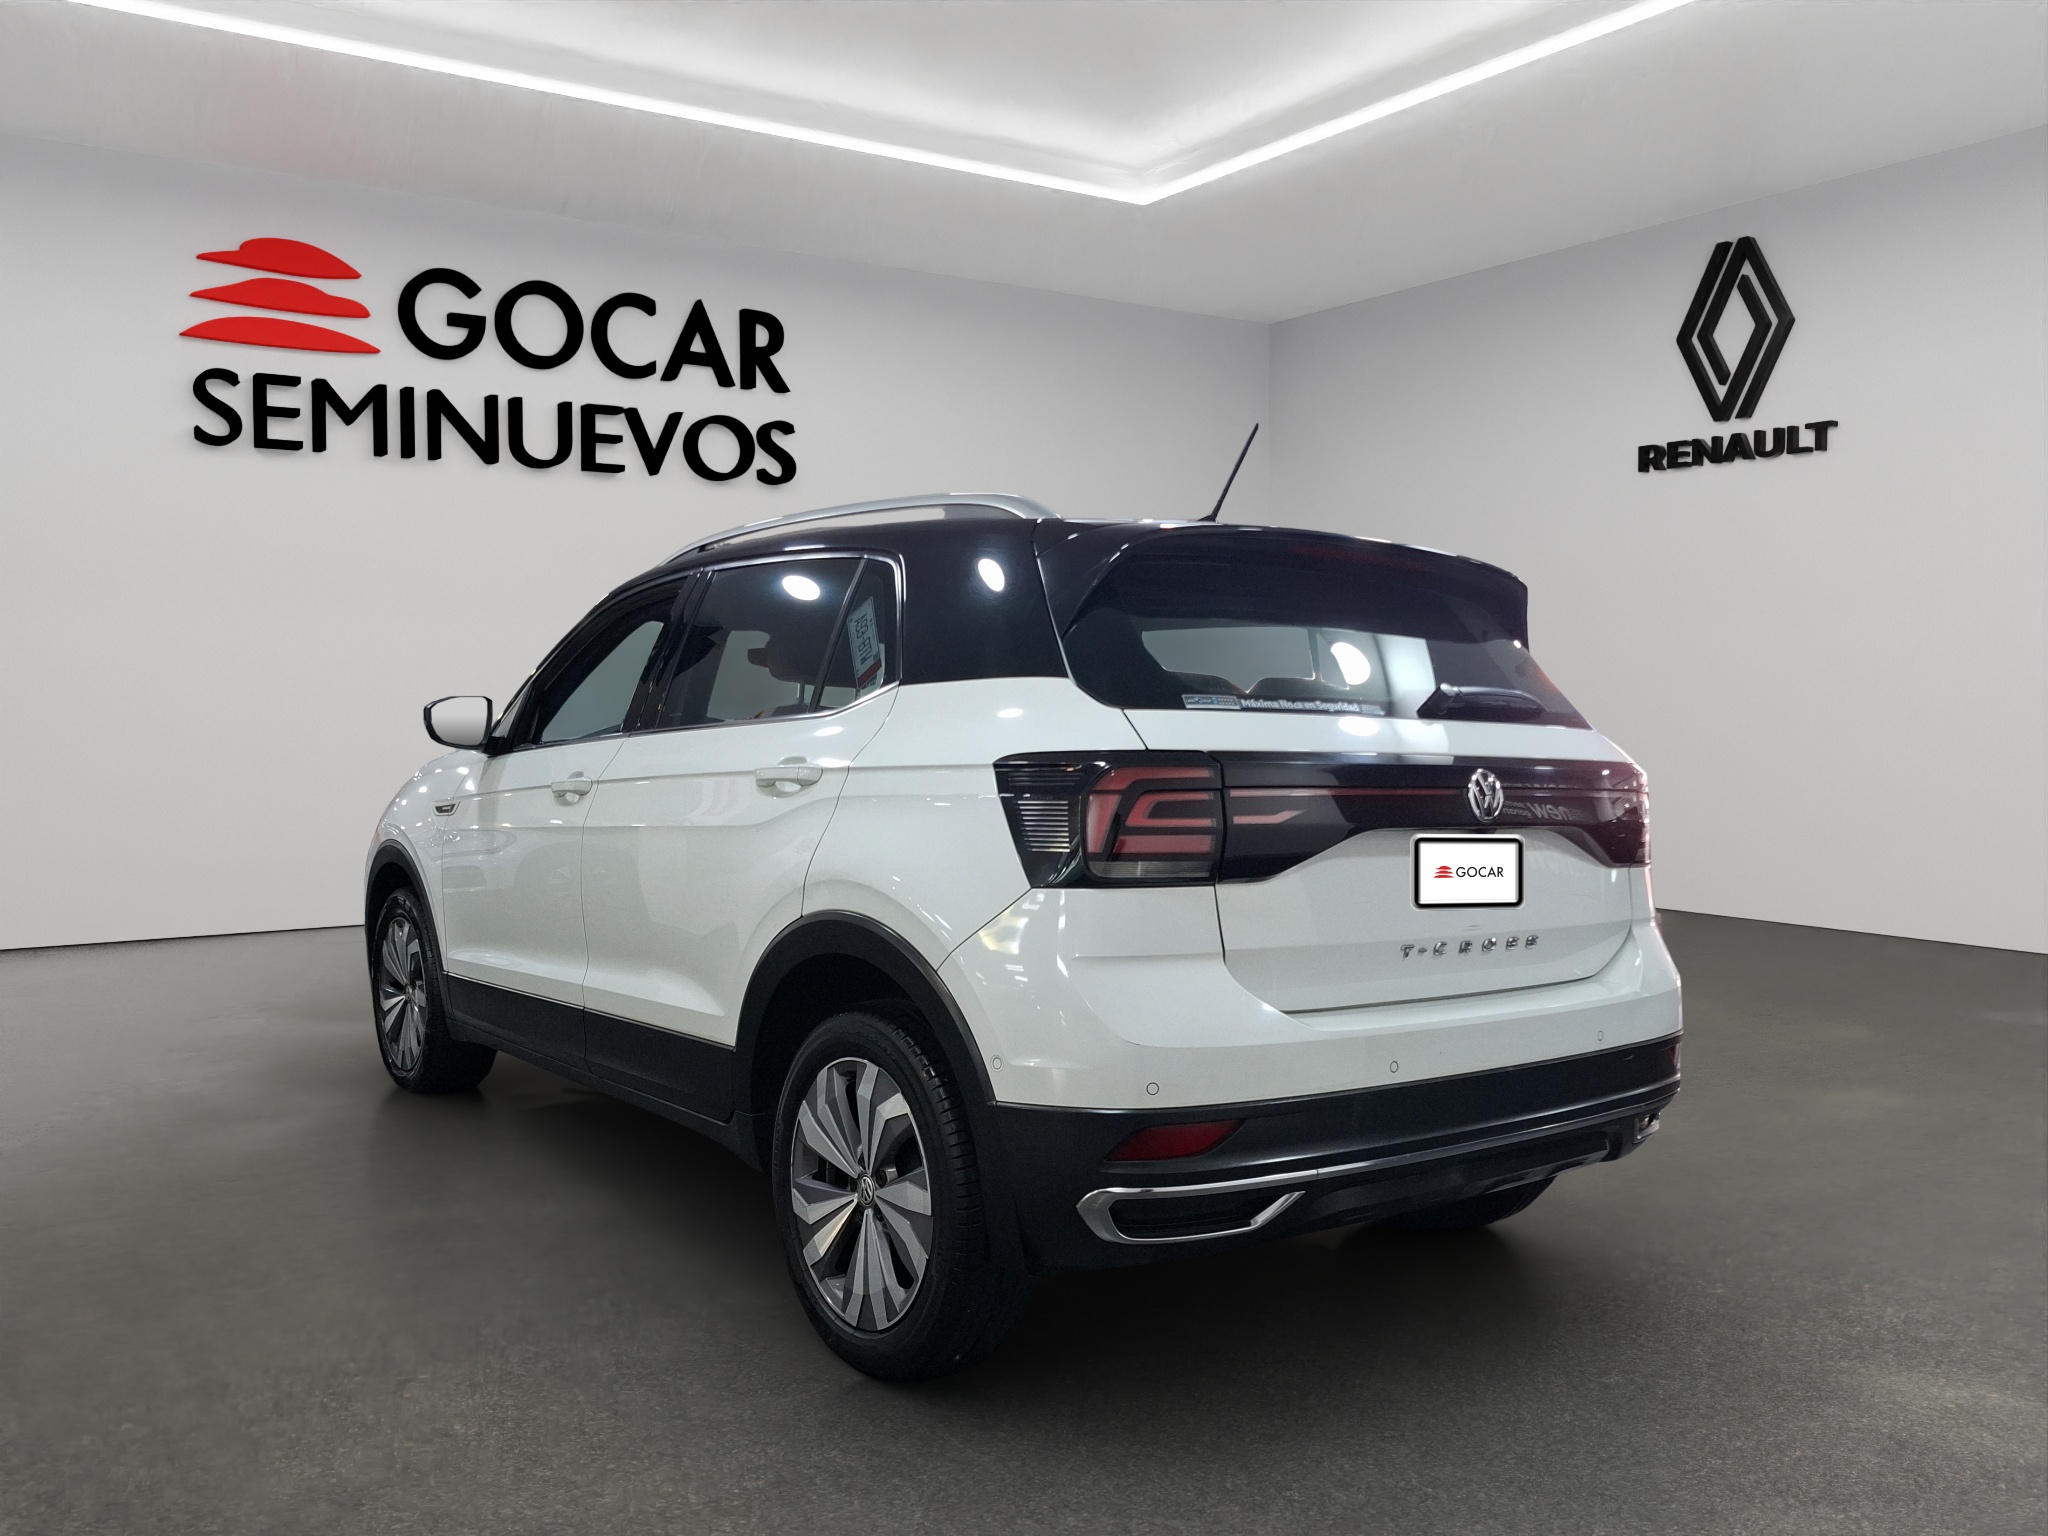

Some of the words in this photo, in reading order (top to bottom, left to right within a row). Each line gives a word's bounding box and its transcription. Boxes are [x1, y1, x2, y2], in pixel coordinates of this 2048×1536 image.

[398, 268, 791, 394] GOCAR
[192, 367, 797, 486] SEMINUEVOS
[1638, 420, 1838, 473] RENAULT
[1241, 699, 1279, 709] Máxima
[1304, 702, 1316, 710] en
[1315, 700, 1360, 712] Seguridad
[1455, 866, 1504, 878] GOCAR
[1400, 934, 1539, 958] T-CROSS
